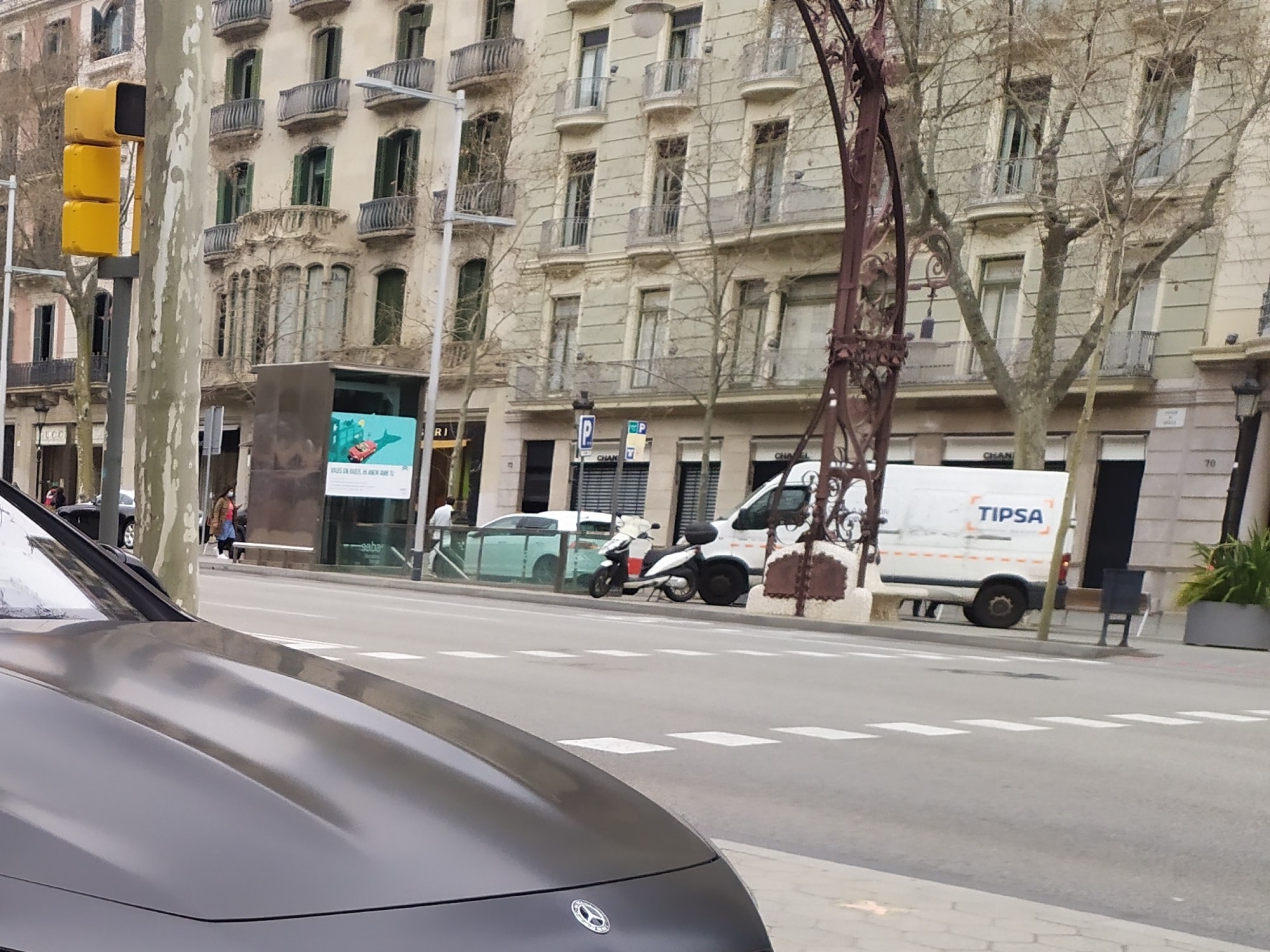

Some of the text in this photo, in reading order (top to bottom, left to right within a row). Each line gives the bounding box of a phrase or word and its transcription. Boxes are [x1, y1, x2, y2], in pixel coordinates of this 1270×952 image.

[583, 420, 592, 446] P
[638, 422, 646, 433] P
[1204, 459, 1216, 468] 70
[978, 505, 1044, 524] TIPSA
